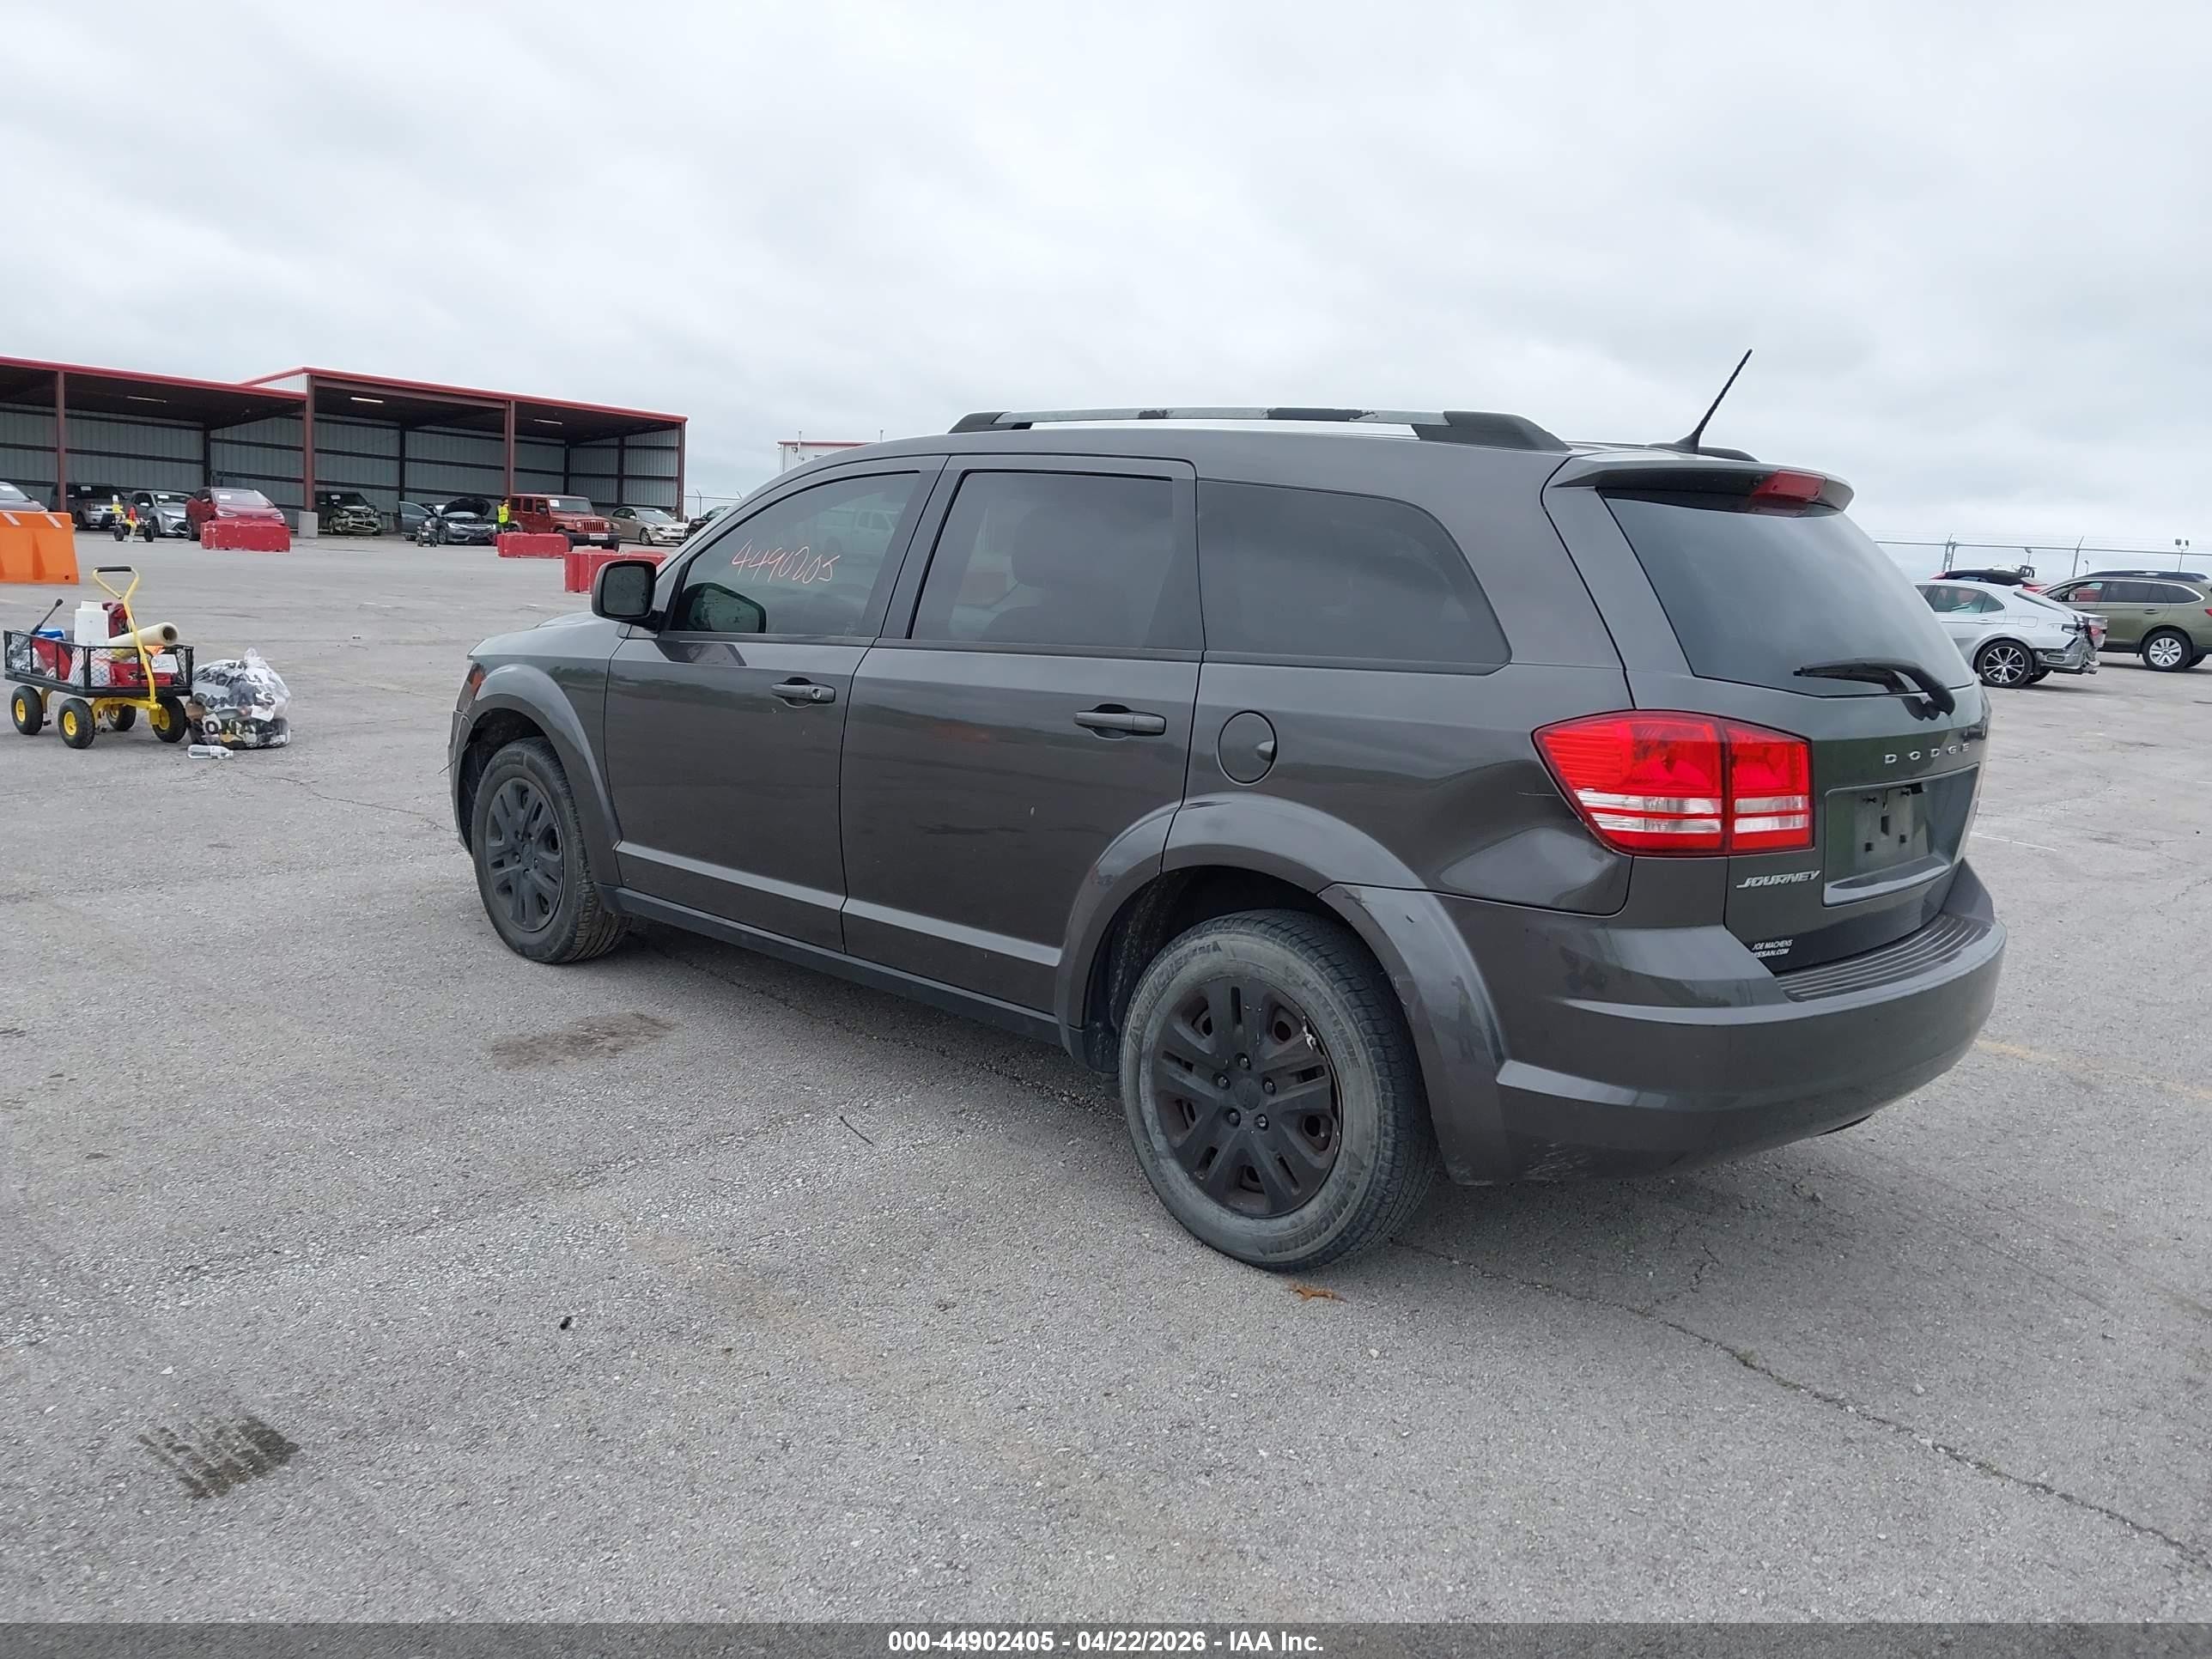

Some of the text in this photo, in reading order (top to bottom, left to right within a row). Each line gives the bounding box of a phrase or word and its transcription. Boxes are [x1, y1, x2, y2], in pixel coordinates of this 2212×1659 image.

[1884, 742, 1971, 765] DODGE
[1735, 870, 1820, 889] JOURNEY
[1752, 942, 1765, 951] JOE
[1752, 947, 1790, 958] ISSAN.COM
